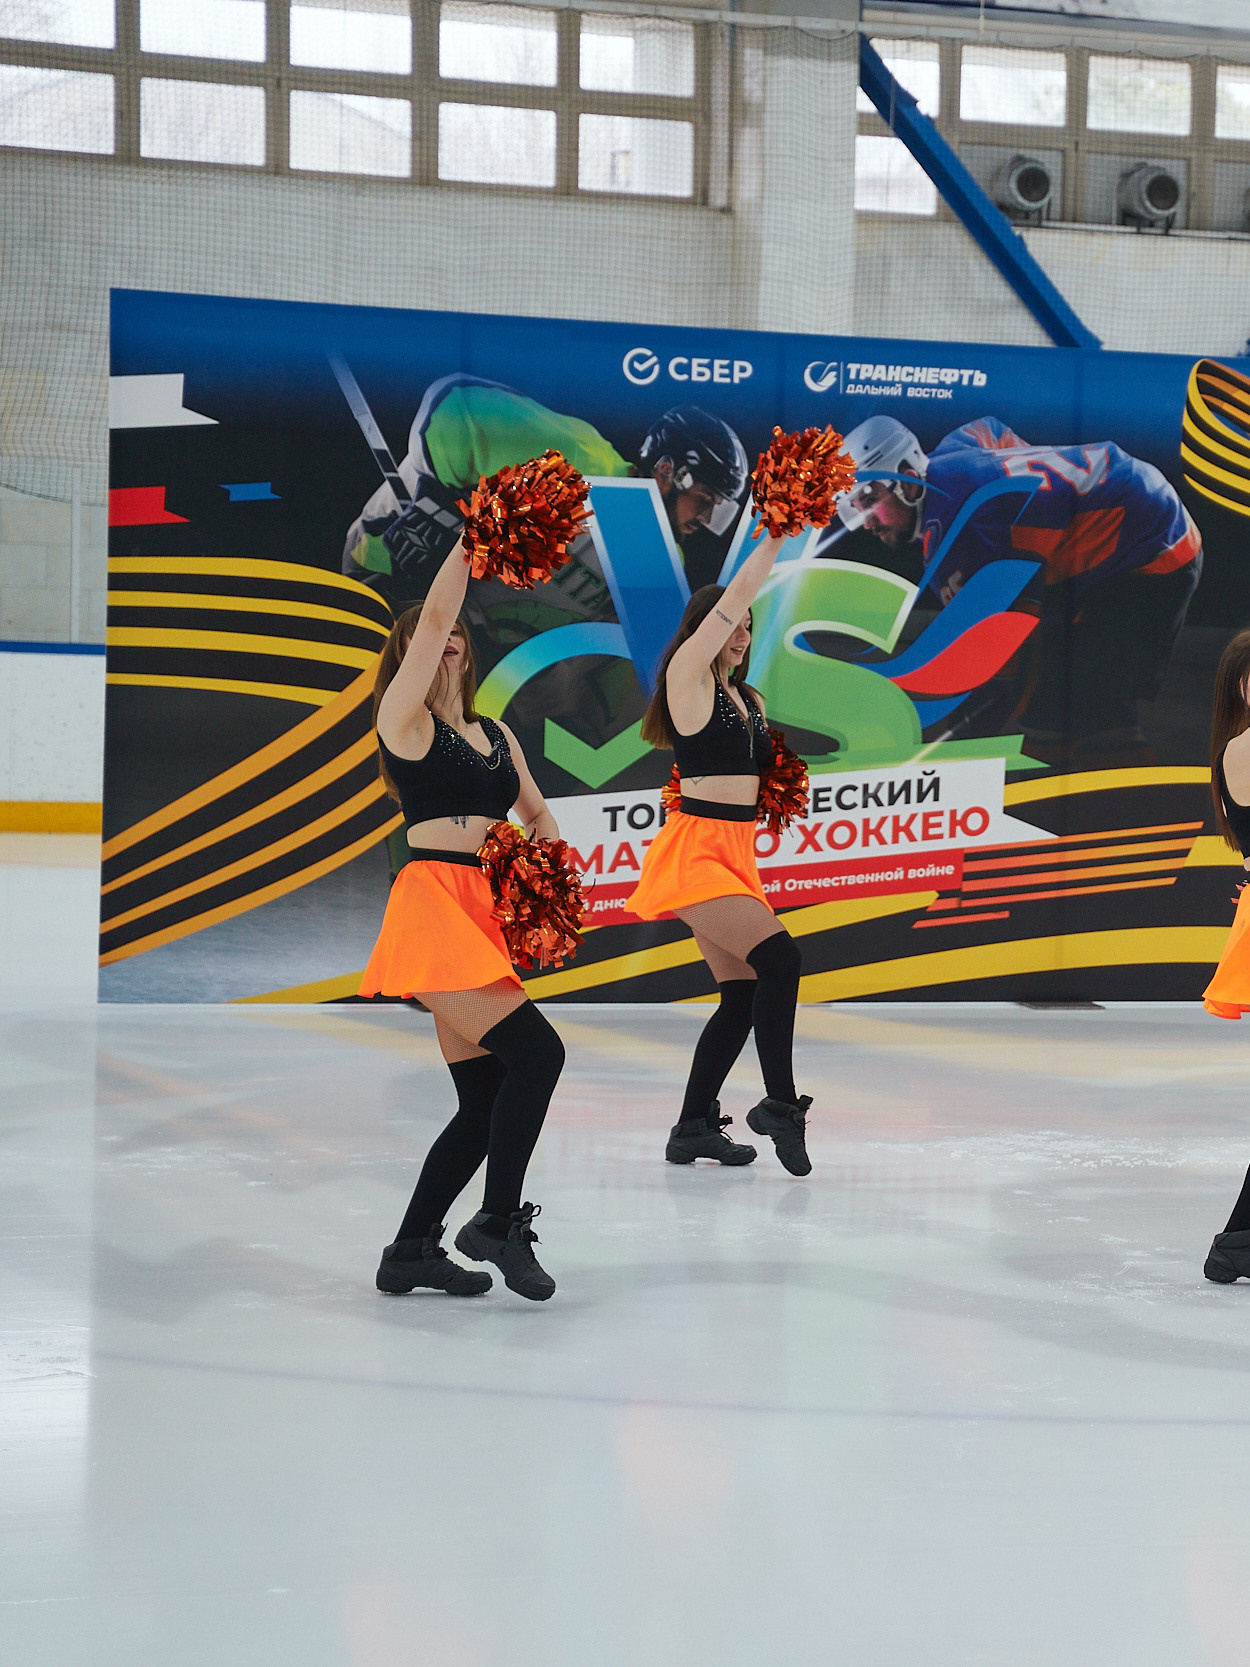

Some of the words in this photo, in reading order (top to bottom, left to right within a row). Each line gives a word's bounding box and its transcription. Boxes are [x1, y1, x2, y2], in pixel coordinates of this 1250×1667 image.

[668, 356, 754, 385] СБЕР
[847, 363, 988, 387] ТРАНСНЕФТЬ
[846, 383, 902, 396] ДАЛЬНИЙ
[906, 387, 953, 399] ВОСТОК
[795, 806, 990, 855] ХОККЕЮ
[784, 867, 904, 892] Отечественной
[908, 864, 955, 881] войне
